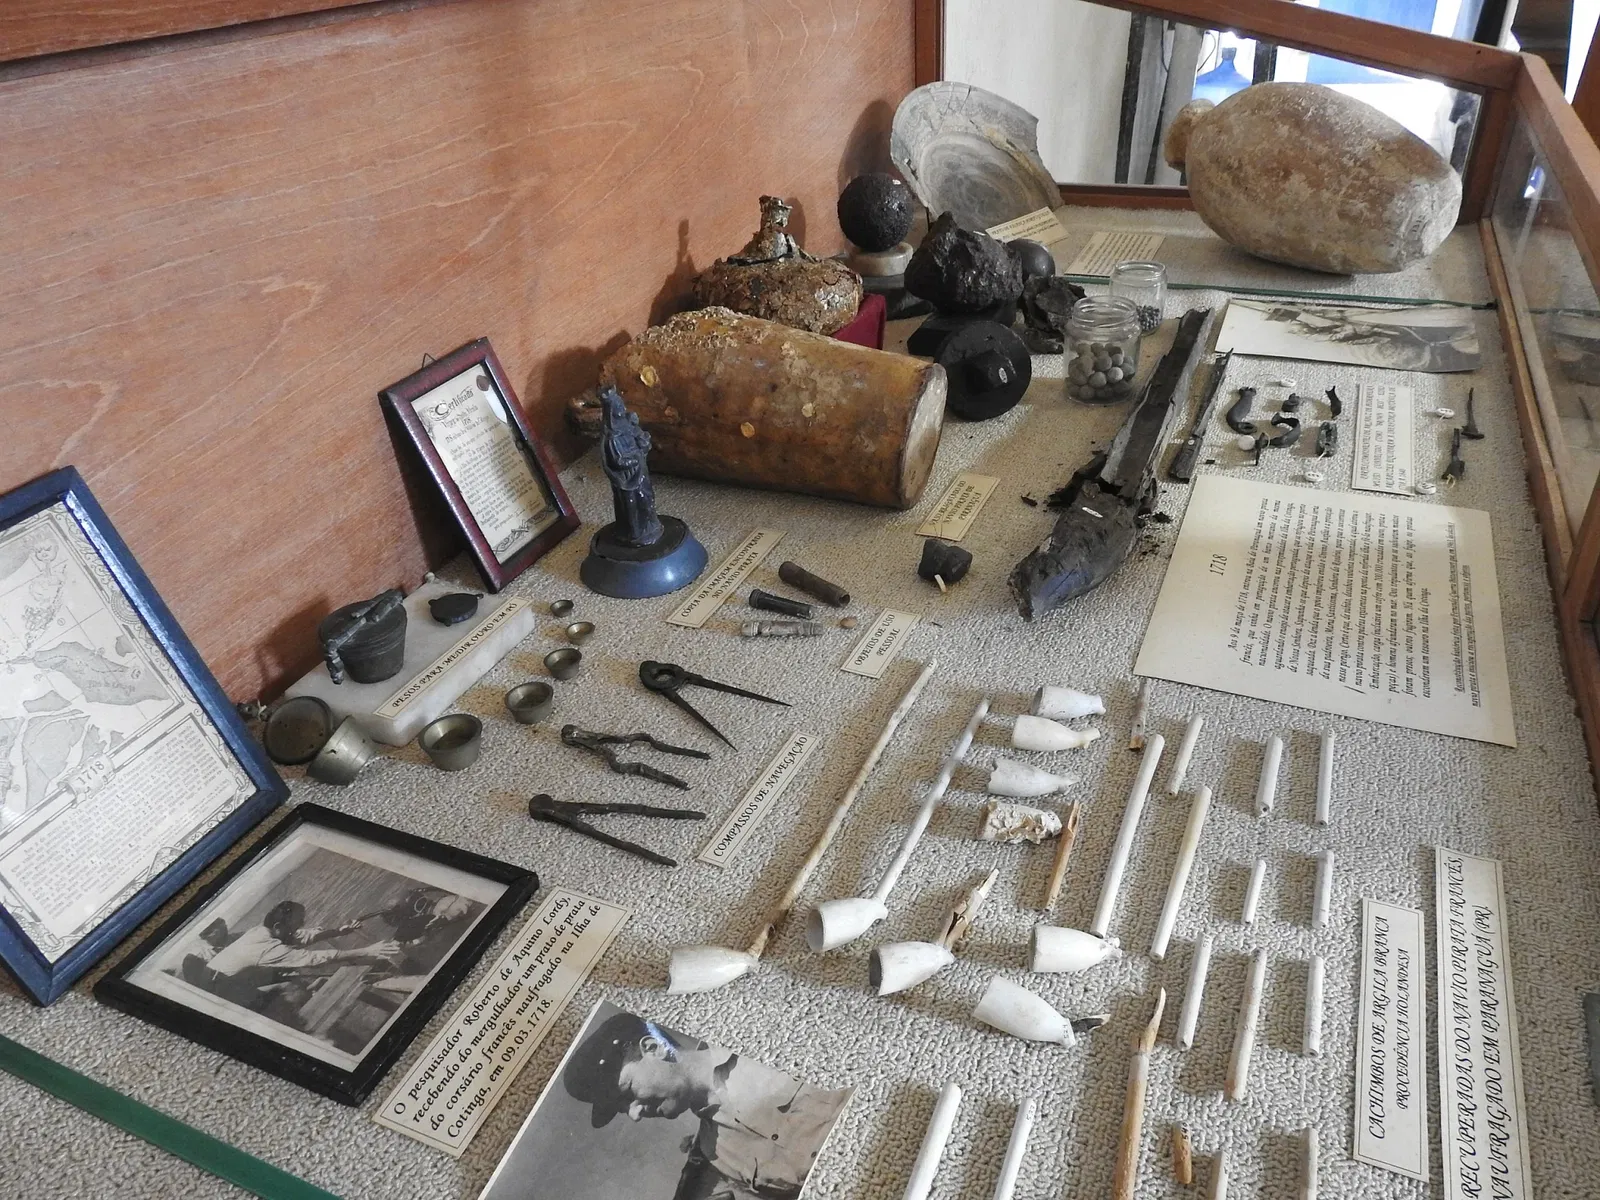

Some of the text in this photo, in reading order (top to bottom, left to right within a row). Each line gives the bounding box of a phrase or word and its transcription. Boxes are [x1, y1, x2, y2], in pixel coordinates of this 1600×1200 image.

[1209, 553, 1227, 575] 1718
[392, 603, 517, 707] PESOS PARA MEDIR OURO EM PÓ
[854, 614, 895, 665] OBJETOS DE USO
[876, 628, 900, 655] PESSOAL
[77, 760, 105, 785] 1718
[713, 736, 807, 856] COMPASSOS DE NAVEGAÇÃO
[1449, 918, 1468, 972] PIRATA
[1450, 973, 1471, 1028] NAVIO
[393, 897, 570, 1114] O pesquisador Roberto de Aquino Lordy,
[413, 900, 585, 1122] recebendo do mergulhador um prato de prata
[430, 905, 600, 1130] do corsário francês naufragado na Ilha de
[1368, 916, 1390, 1138] CACHIMBOS DE ARGILA BRANCA
[1393, 948, 1410, 1109] PROCEDÊNCIA HOLANDESA
[1454, 1027, 1470, 1053] DO
[447, 999, 553, 1137] Cotinga, em 09.03.1718.
[1455, 1054, 1482, 1200] RECUPERADAS
